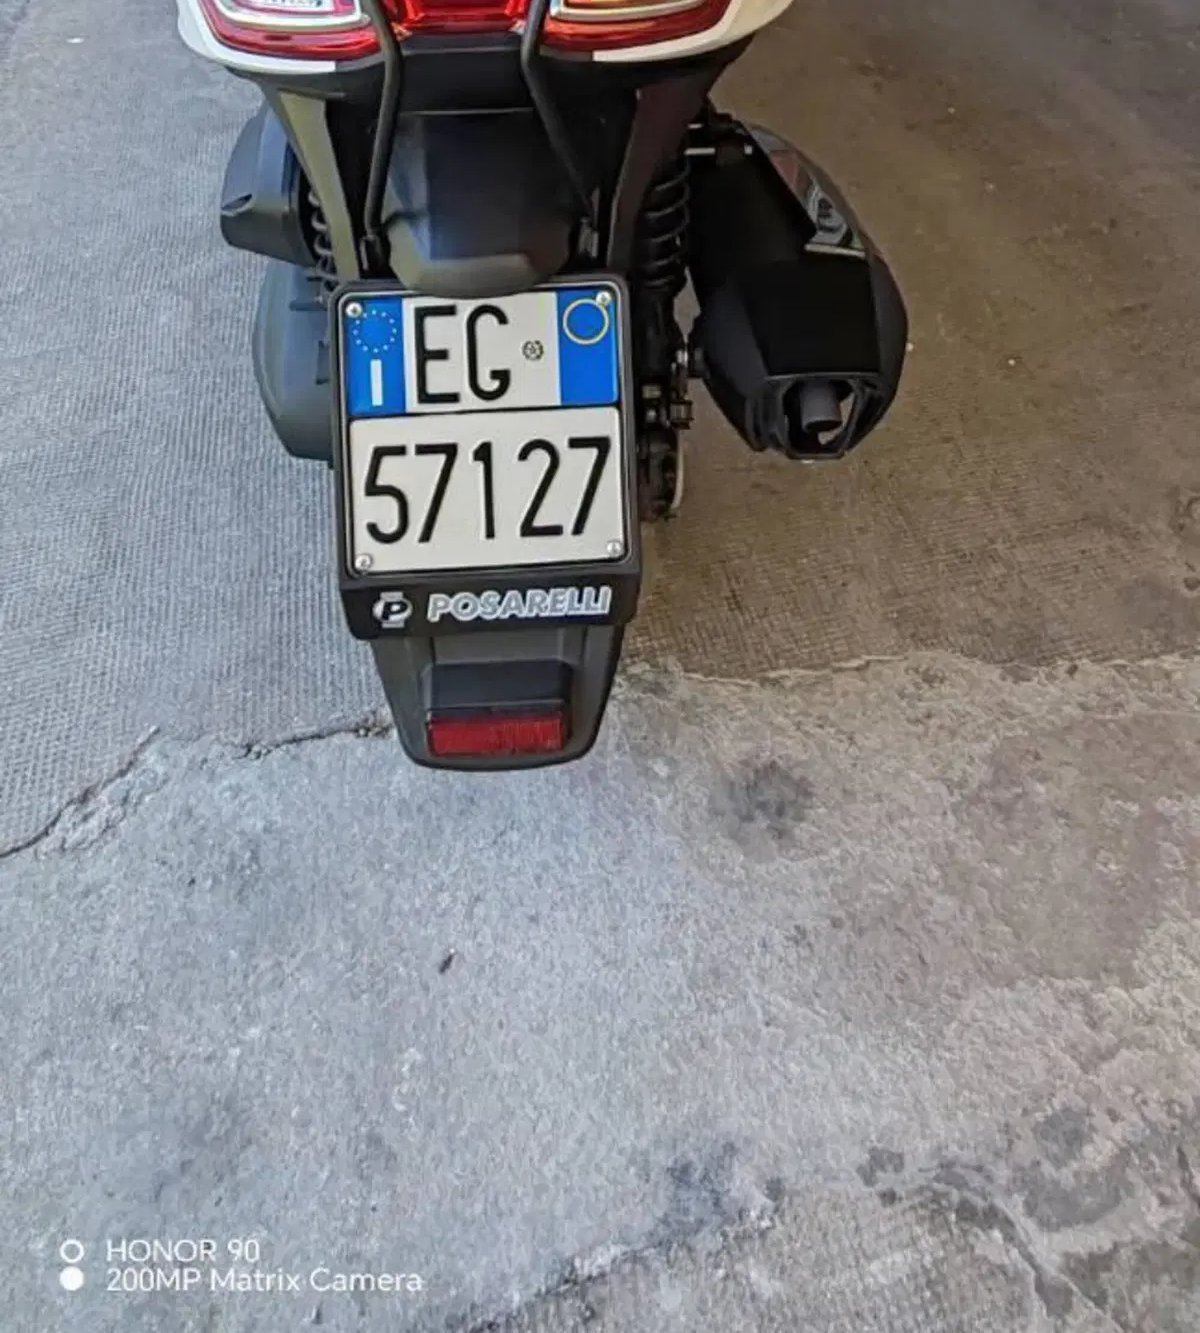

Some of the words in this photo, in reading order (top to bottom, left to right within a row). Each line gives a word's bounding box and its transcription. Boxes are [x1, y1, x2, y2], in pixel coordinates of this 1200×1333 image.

[413, 304, 511, 405] EG
[364, 436, 611, 544] 57127
[427, 586, 613, 623] POSARELLI
